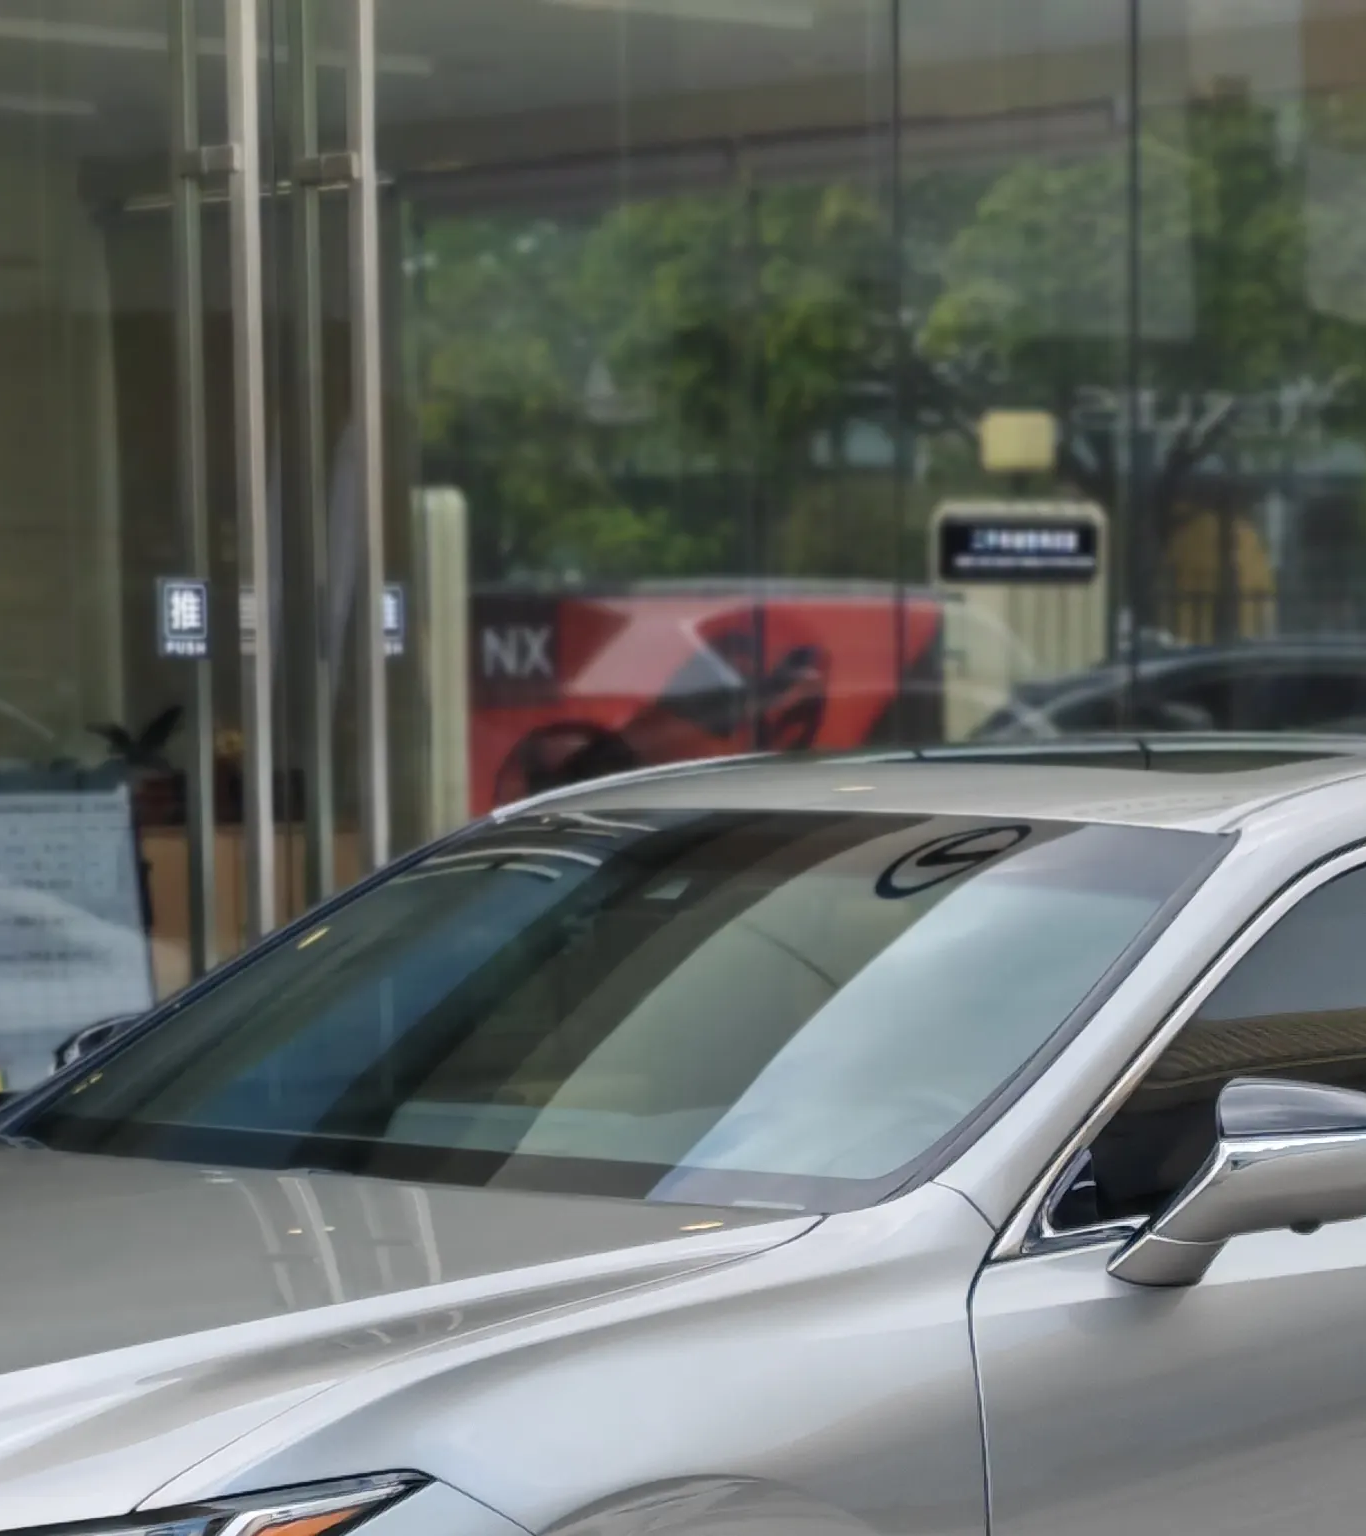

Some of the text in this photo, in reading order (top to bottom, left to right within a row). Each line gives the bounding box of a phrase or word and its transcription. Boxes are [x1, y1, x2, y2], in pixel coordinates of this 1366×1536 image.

[171, 590, 202, 630] 推
[165, 640, 207, 656] PUSH
[481, 623, 553, 678] NX
